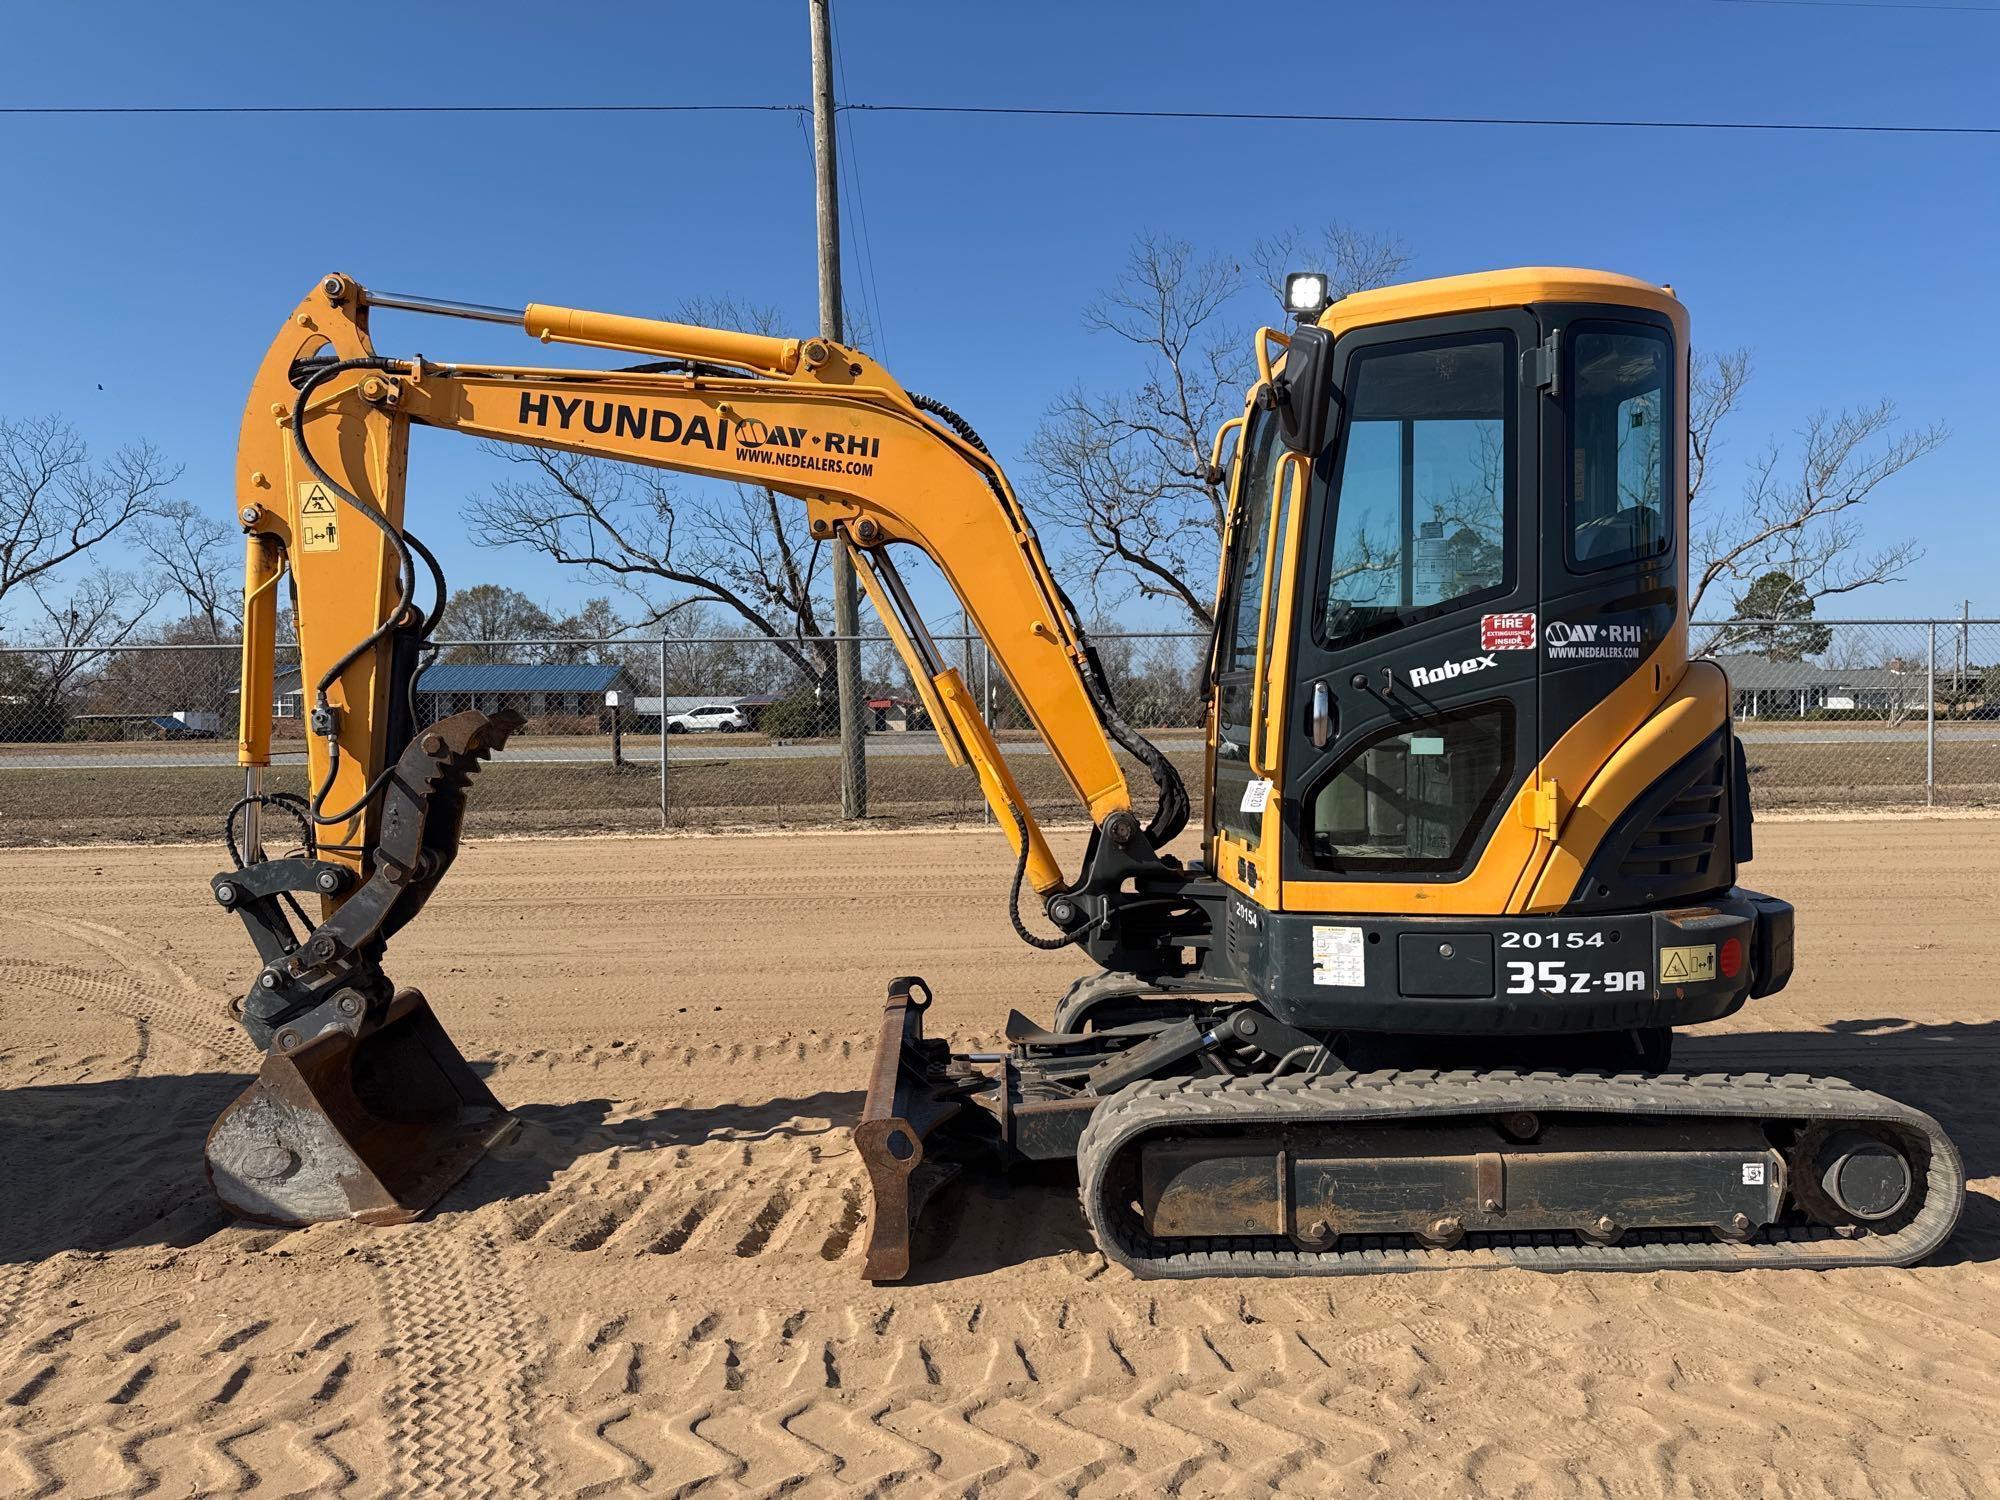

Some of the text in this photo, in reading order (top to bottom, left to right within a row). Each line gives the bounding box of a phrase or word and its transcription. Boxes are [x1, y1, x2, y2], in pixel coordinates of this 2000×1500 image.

[519, 392, 728, 451] HYUNDAI
[736, 447, 874, 477] WWW.NEDEALERS.COM
[1494, 618, 1523, 628] FIRE
[1548, 647, 1639, 658] WWW.NEDEALERS.COM
[1409, 653, 1498, 687] Robex
[1236, 902, 1257, 928] 20154
[1501, 932, 1604, 949] 20154
